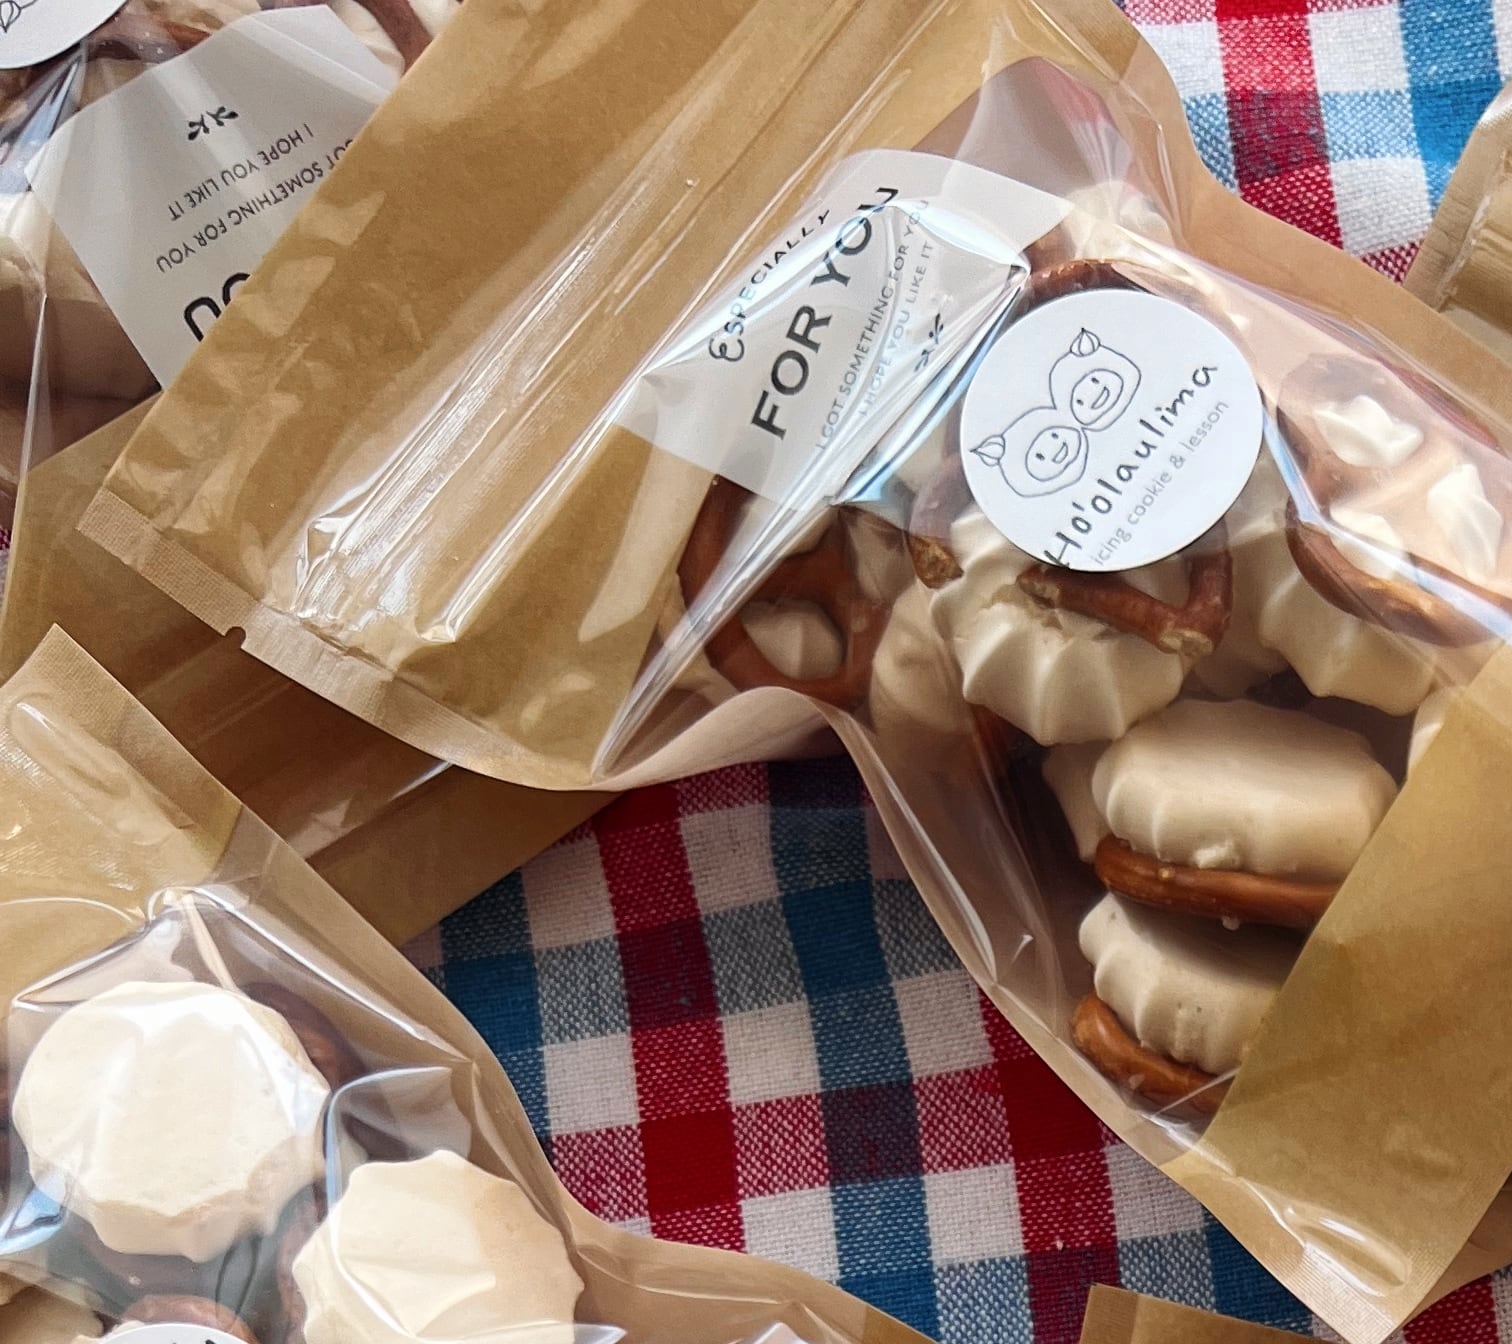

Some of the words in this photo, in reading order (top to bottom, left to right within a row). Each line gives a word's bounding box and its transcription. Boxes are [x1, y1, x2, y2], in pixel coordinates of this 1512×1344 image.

[258, 130, 303, 165] HOPE
[184, 178, 219, 208] LIKE
[221, 160, 259, 185] YOU
[228, 161, 323, 224] SOMETHING
[168, 204, 184, 220] IT
[193, 218, 227, 246] FOR
[156, 242, 196, 272] YOU
[905, 266, 927, 303] LIKE
[921, 240, 933, 259] IT
[709, 209, 830, 362] ESPECIALLY
[751, 305, 832, 440] FOR
[811, 187, 898, 287] YOU
[822, 398, 844, 438] GOT
[839, 286, 894, 396] SOMETHING
[889, 244, 909, 281] FOR
[904, 200, 929, 237] YOU
[1090, 528, 1132, 566] icing
[1128, 470, 1172, 525] cookie
[1169, 455, 1186, 469] &
[1181, 402, 1229, 452] lesson
